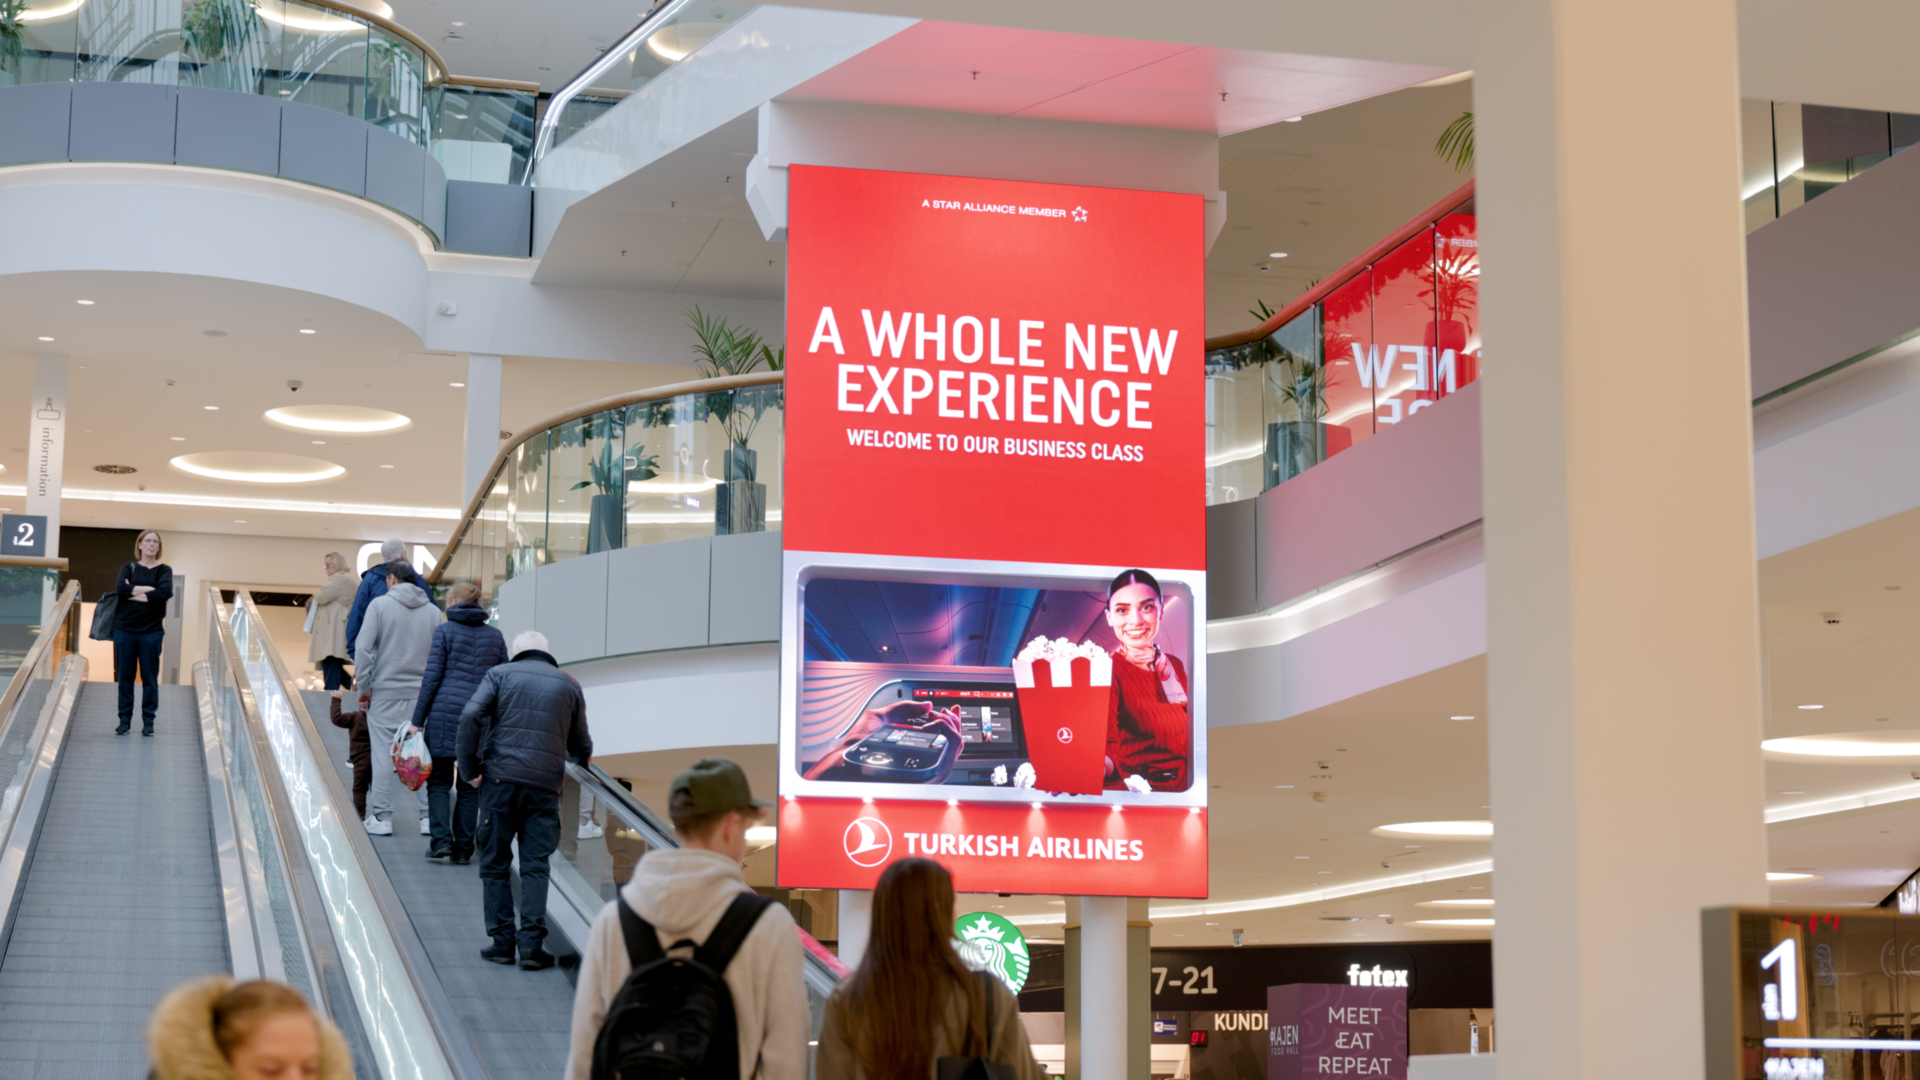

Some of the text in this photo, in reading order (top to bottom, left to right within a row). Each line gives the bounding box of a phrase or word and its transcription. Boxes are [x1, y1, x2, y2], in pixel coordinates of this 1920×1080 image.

[922, 199, 1066, 218] A STAR ALLIANCE MEMBER
[809, 306, 1178, 376] A WHOLE NEW
[838, 364, 1152, 429] EXPERIENCE
[847, 429, 1144, 461] WELCOME TO OUR BUSINESS CLASS
[38, 427, 54, 497] information
[18, 523, 34, 546] 2
[904, 833, 1144, 861] TURKISH AIRLINES
[1151, 966, 1218, 995] 7-21
[1214, 1013, 1268, 1031] KUND
[1329, 1007, 1382, 1025] MEET
[1270, 1025, 1299, 1046] KAJEN
[1335, 1032, 1374, 1049] EAT
[1271, 1046, 1299, 1055] FOOD HALL
[1319, 1056, 1392, 1075] REPEAT
